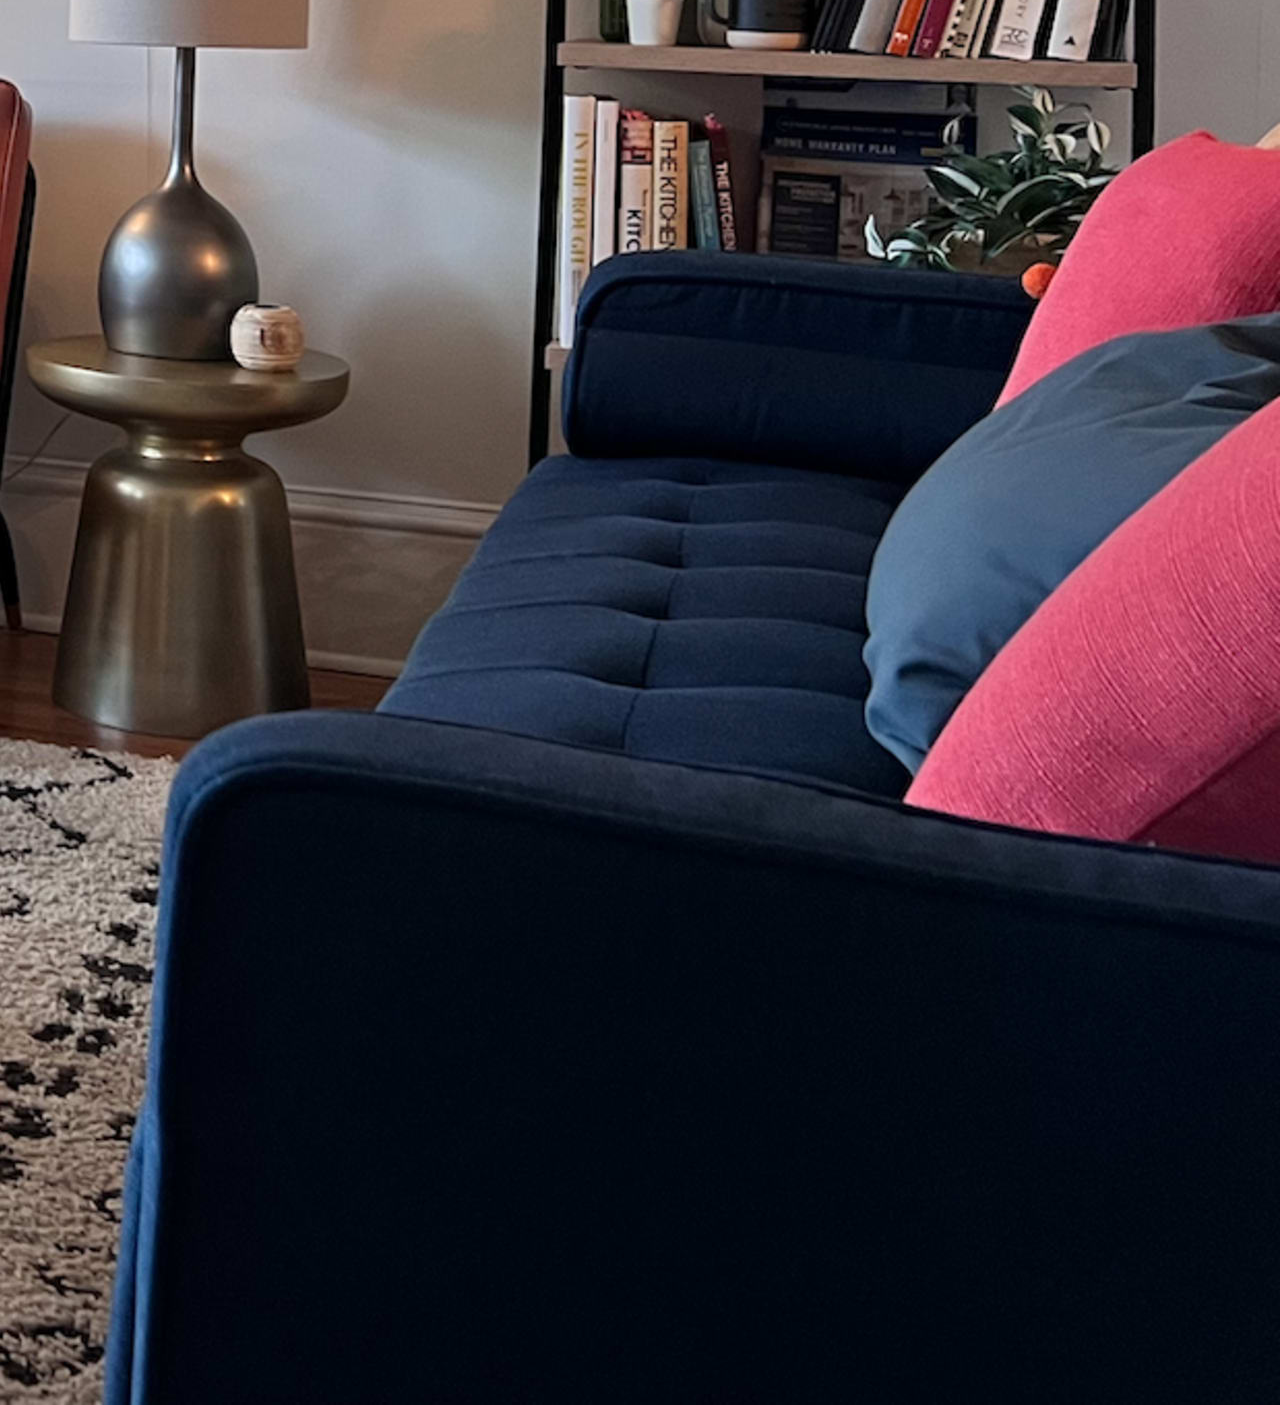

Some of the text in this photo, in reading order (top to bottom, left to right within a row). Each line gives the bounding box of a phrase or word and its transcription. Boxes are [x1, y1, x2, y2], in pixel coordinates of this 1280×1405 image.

[574, 132, 589, 150] IN
[659, 137, 678, 172] THE
[774, 137, 897, 156] HOME WARRANTY PLAN
[715, 161, 738, 252] THE KITCHEN
[570, 196, 586, 264] ROUGH
